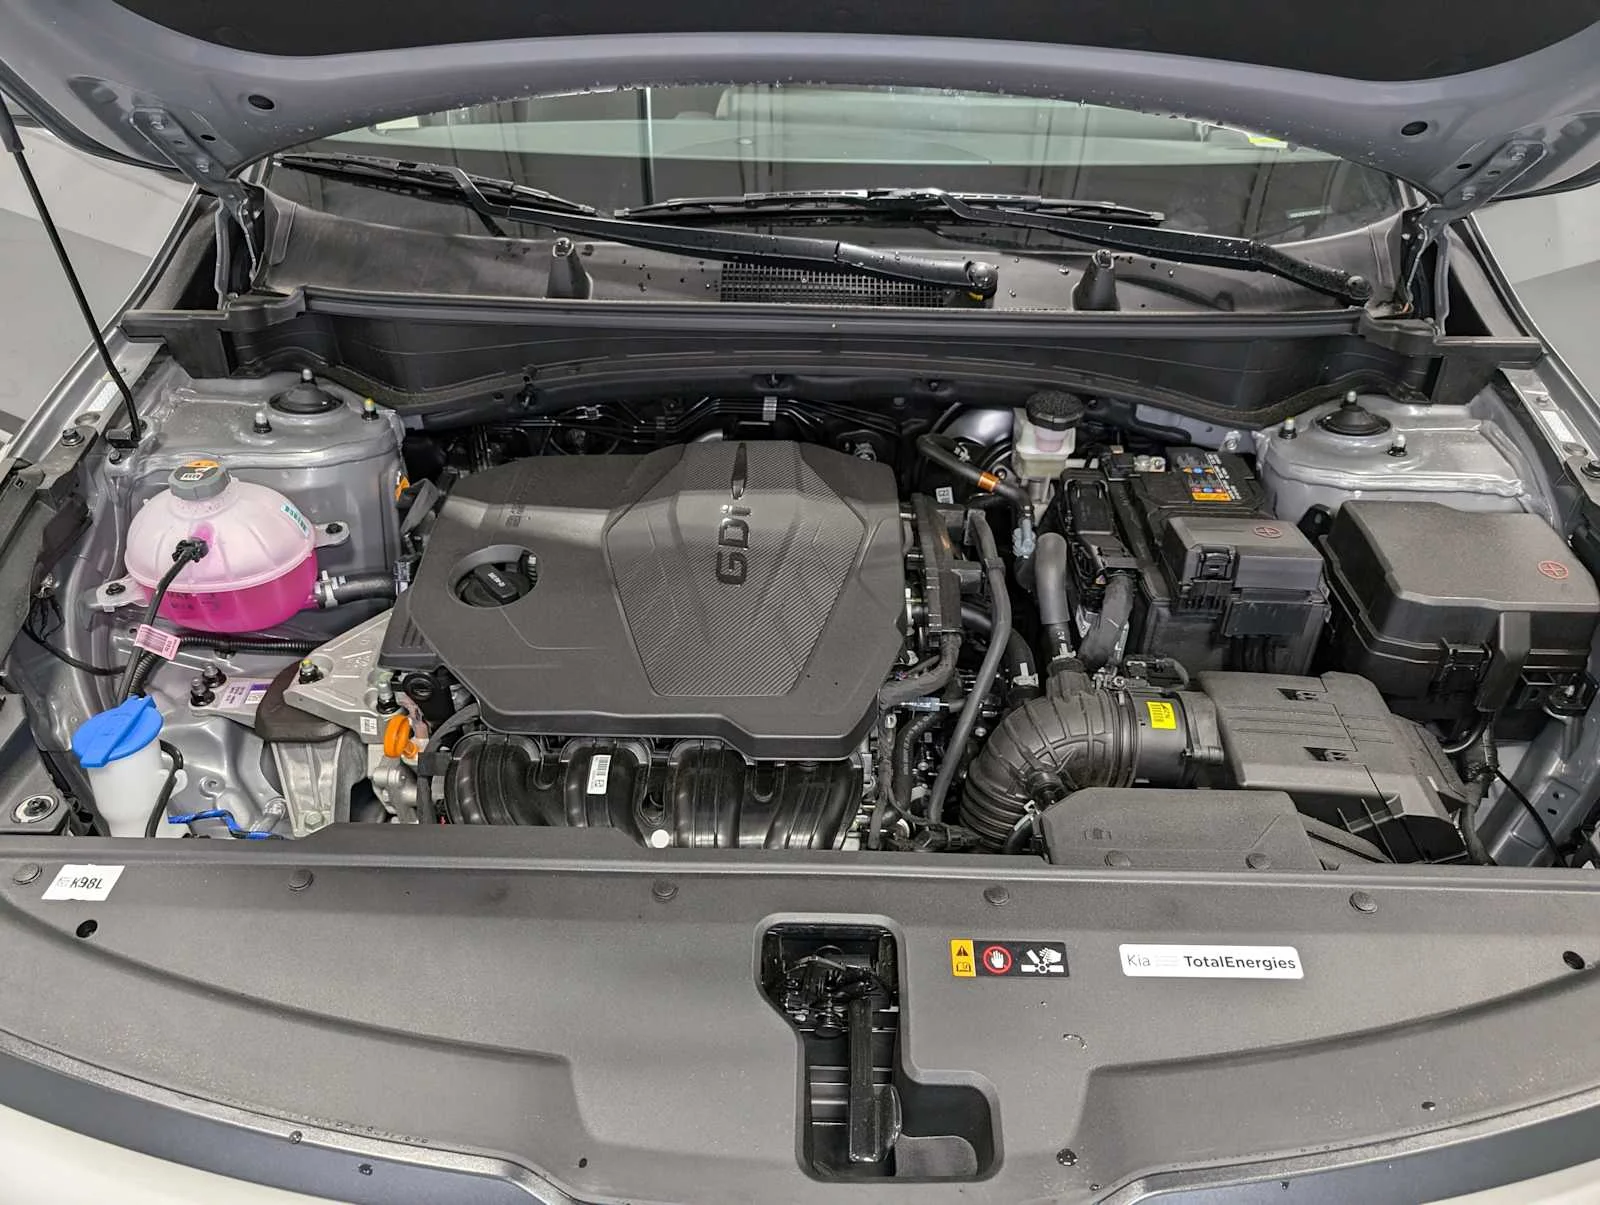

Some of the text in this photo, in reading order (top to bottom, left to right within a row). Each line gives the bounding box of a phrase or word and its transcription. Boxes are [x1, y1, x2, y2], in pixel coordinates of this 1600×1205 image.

[716, 504, 752, 586] GDi
[70, 876, 103, 889] K98L
[1127, 954, 1296, 971] Kia TotalEnergies
